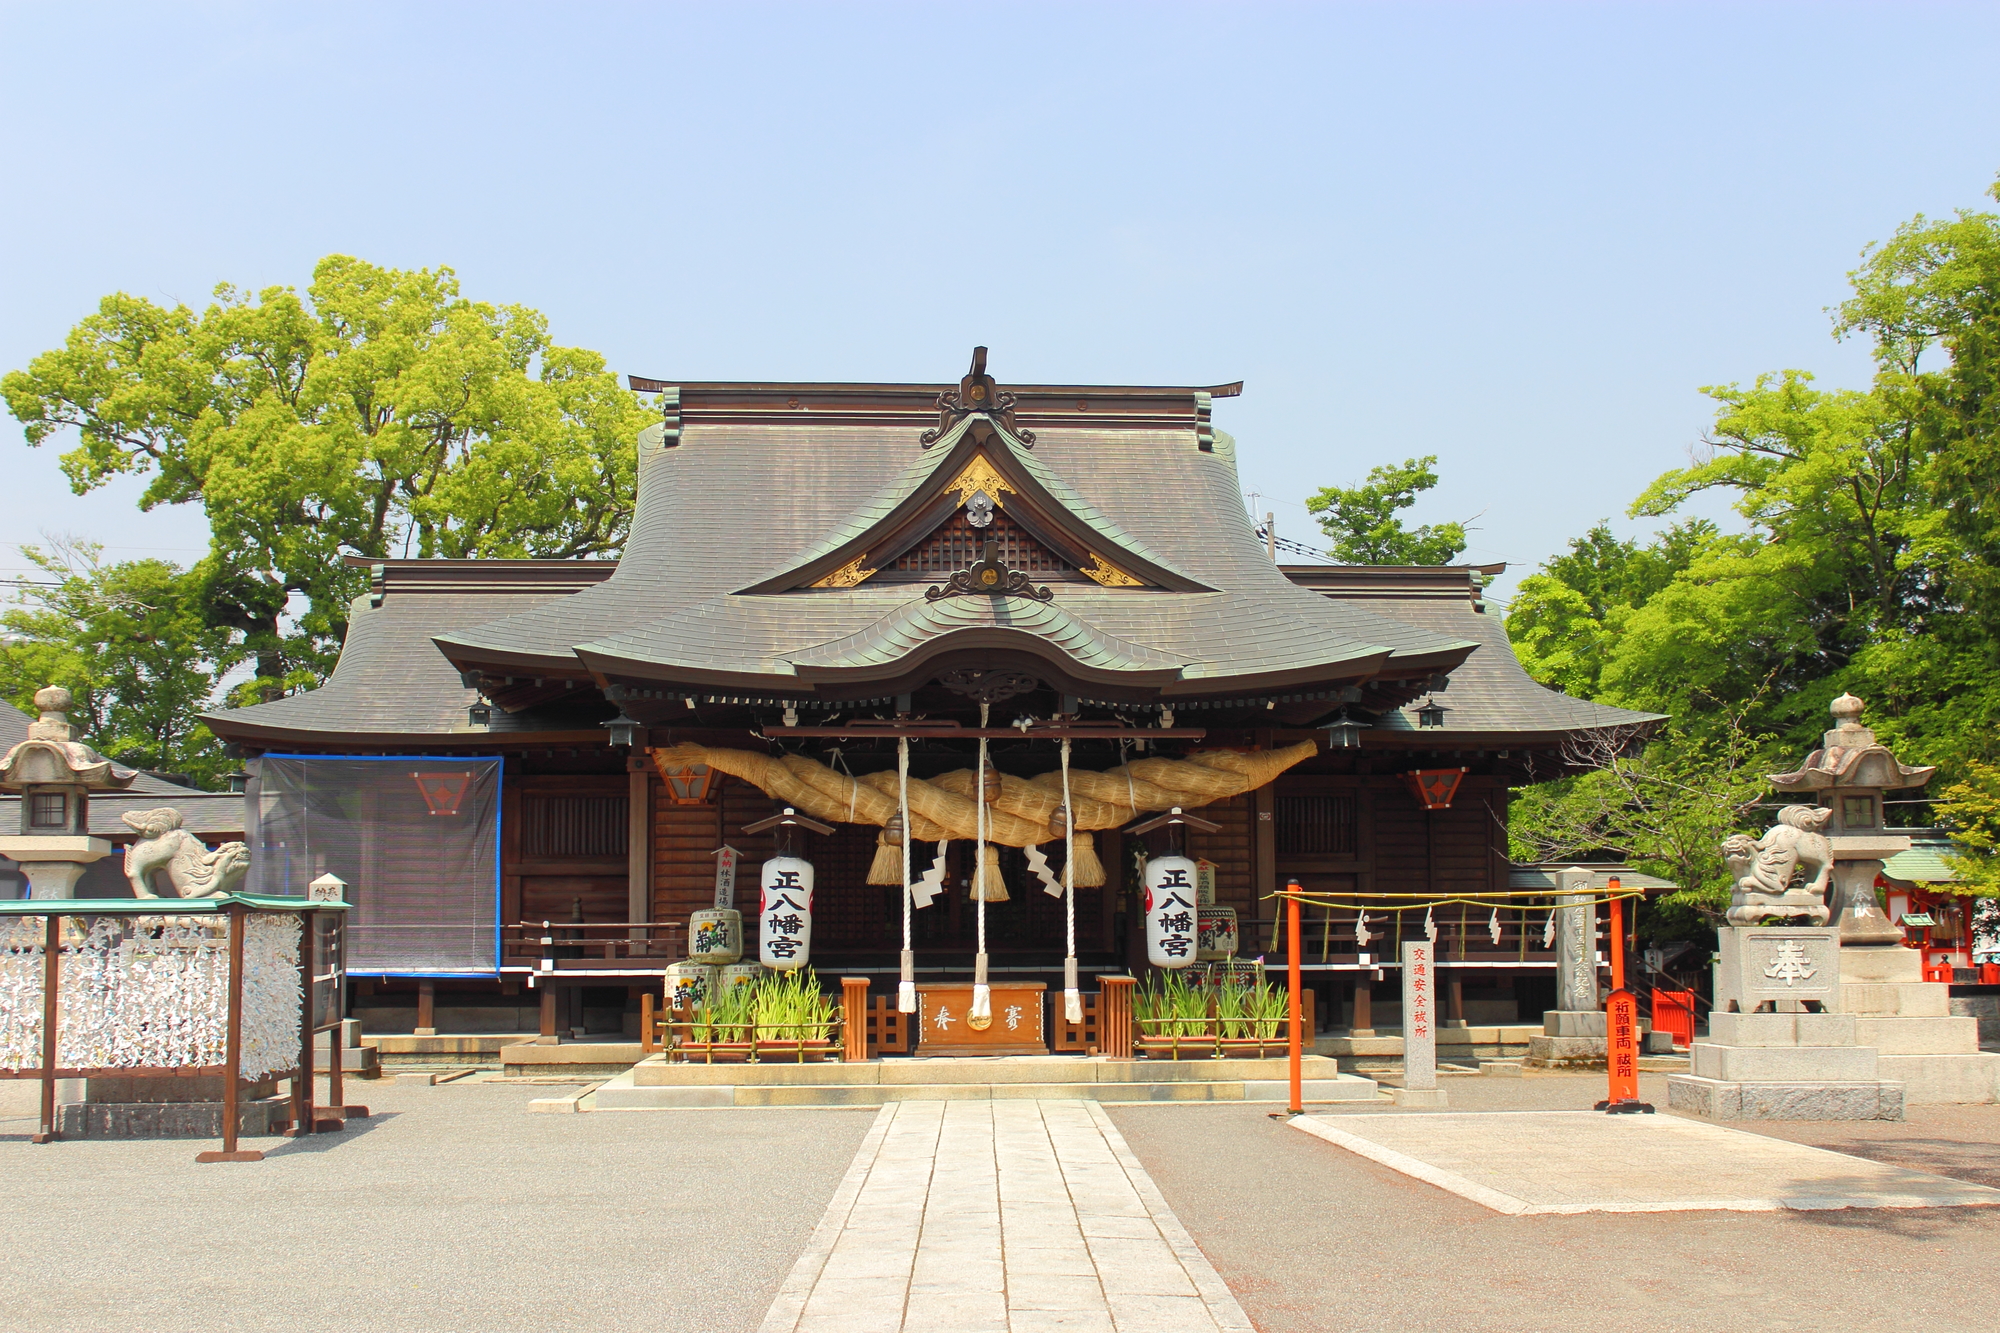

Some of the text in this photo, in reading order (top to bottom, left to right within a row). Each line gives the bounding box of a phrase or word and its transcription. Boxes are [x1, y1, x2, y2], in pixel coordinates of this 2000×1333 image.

[768, 871, 804, 958] 正八幡宮
[1157, 869, 1194, 957] 正八幡宮
[1763, 940, 1817, 986] 奉
